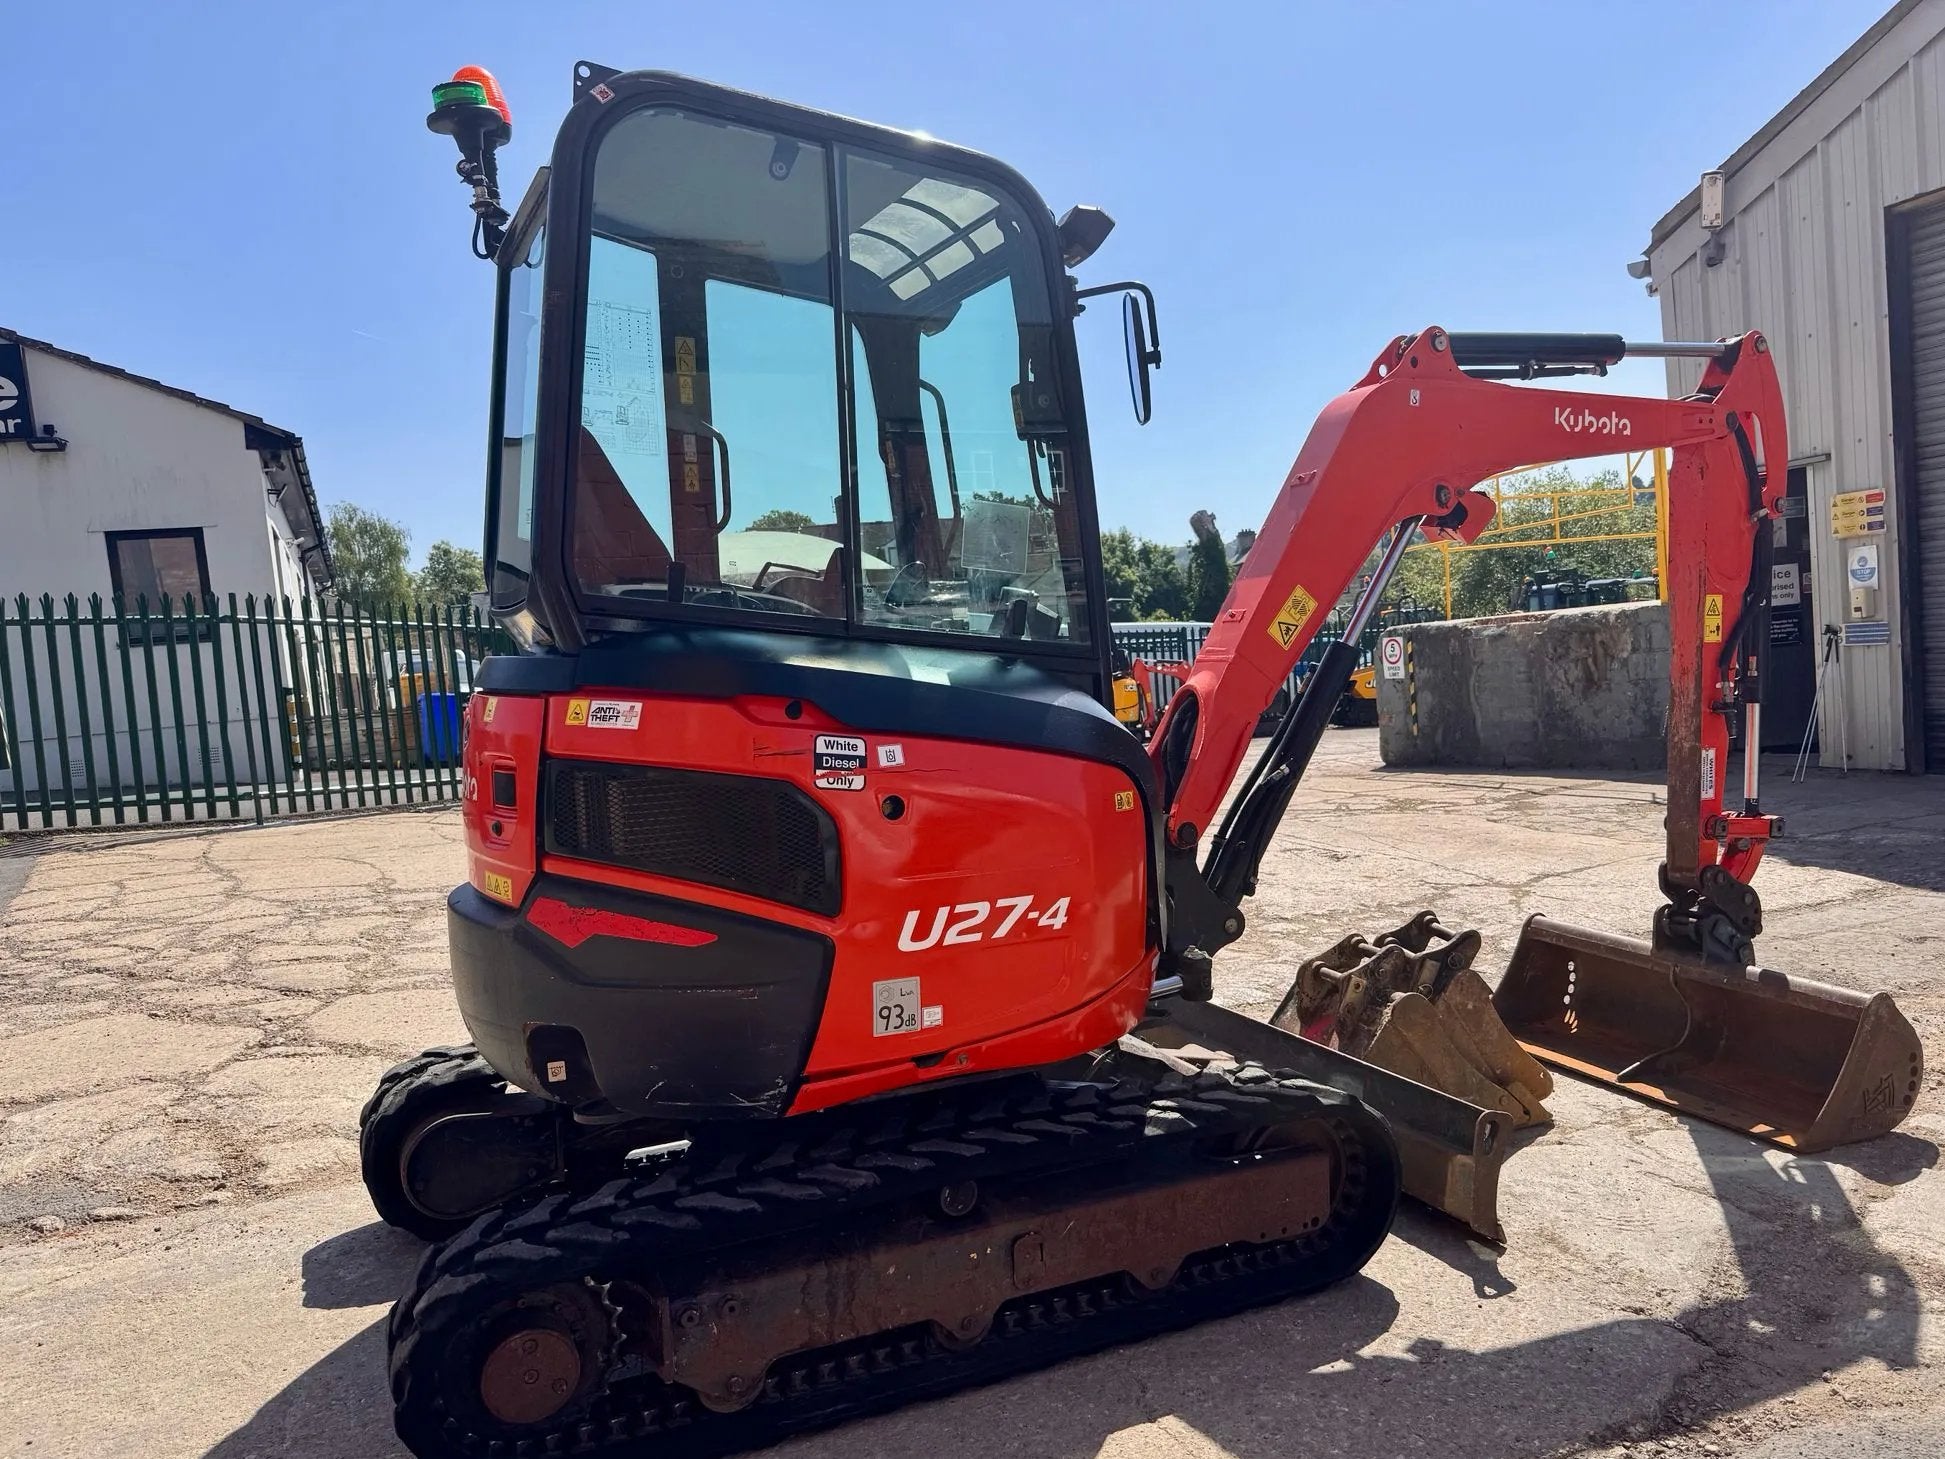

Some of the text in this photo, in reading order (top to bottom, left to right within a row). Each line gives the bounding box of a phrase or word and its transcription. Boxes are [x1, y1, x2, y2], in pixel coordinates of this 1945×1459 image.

[1554, 406, 1631, 436] Kubota
[1779, 592, 1795, 600] only
[1390, 643, 1396, 653] 5
[590, 714, 621, 723] THEFT
[823, 739, 859, 752] White
[822, 756, 860, 768] Diesel
[826, 776, 855, 788] Only
[897, 894, 1072, 953] U27-4
